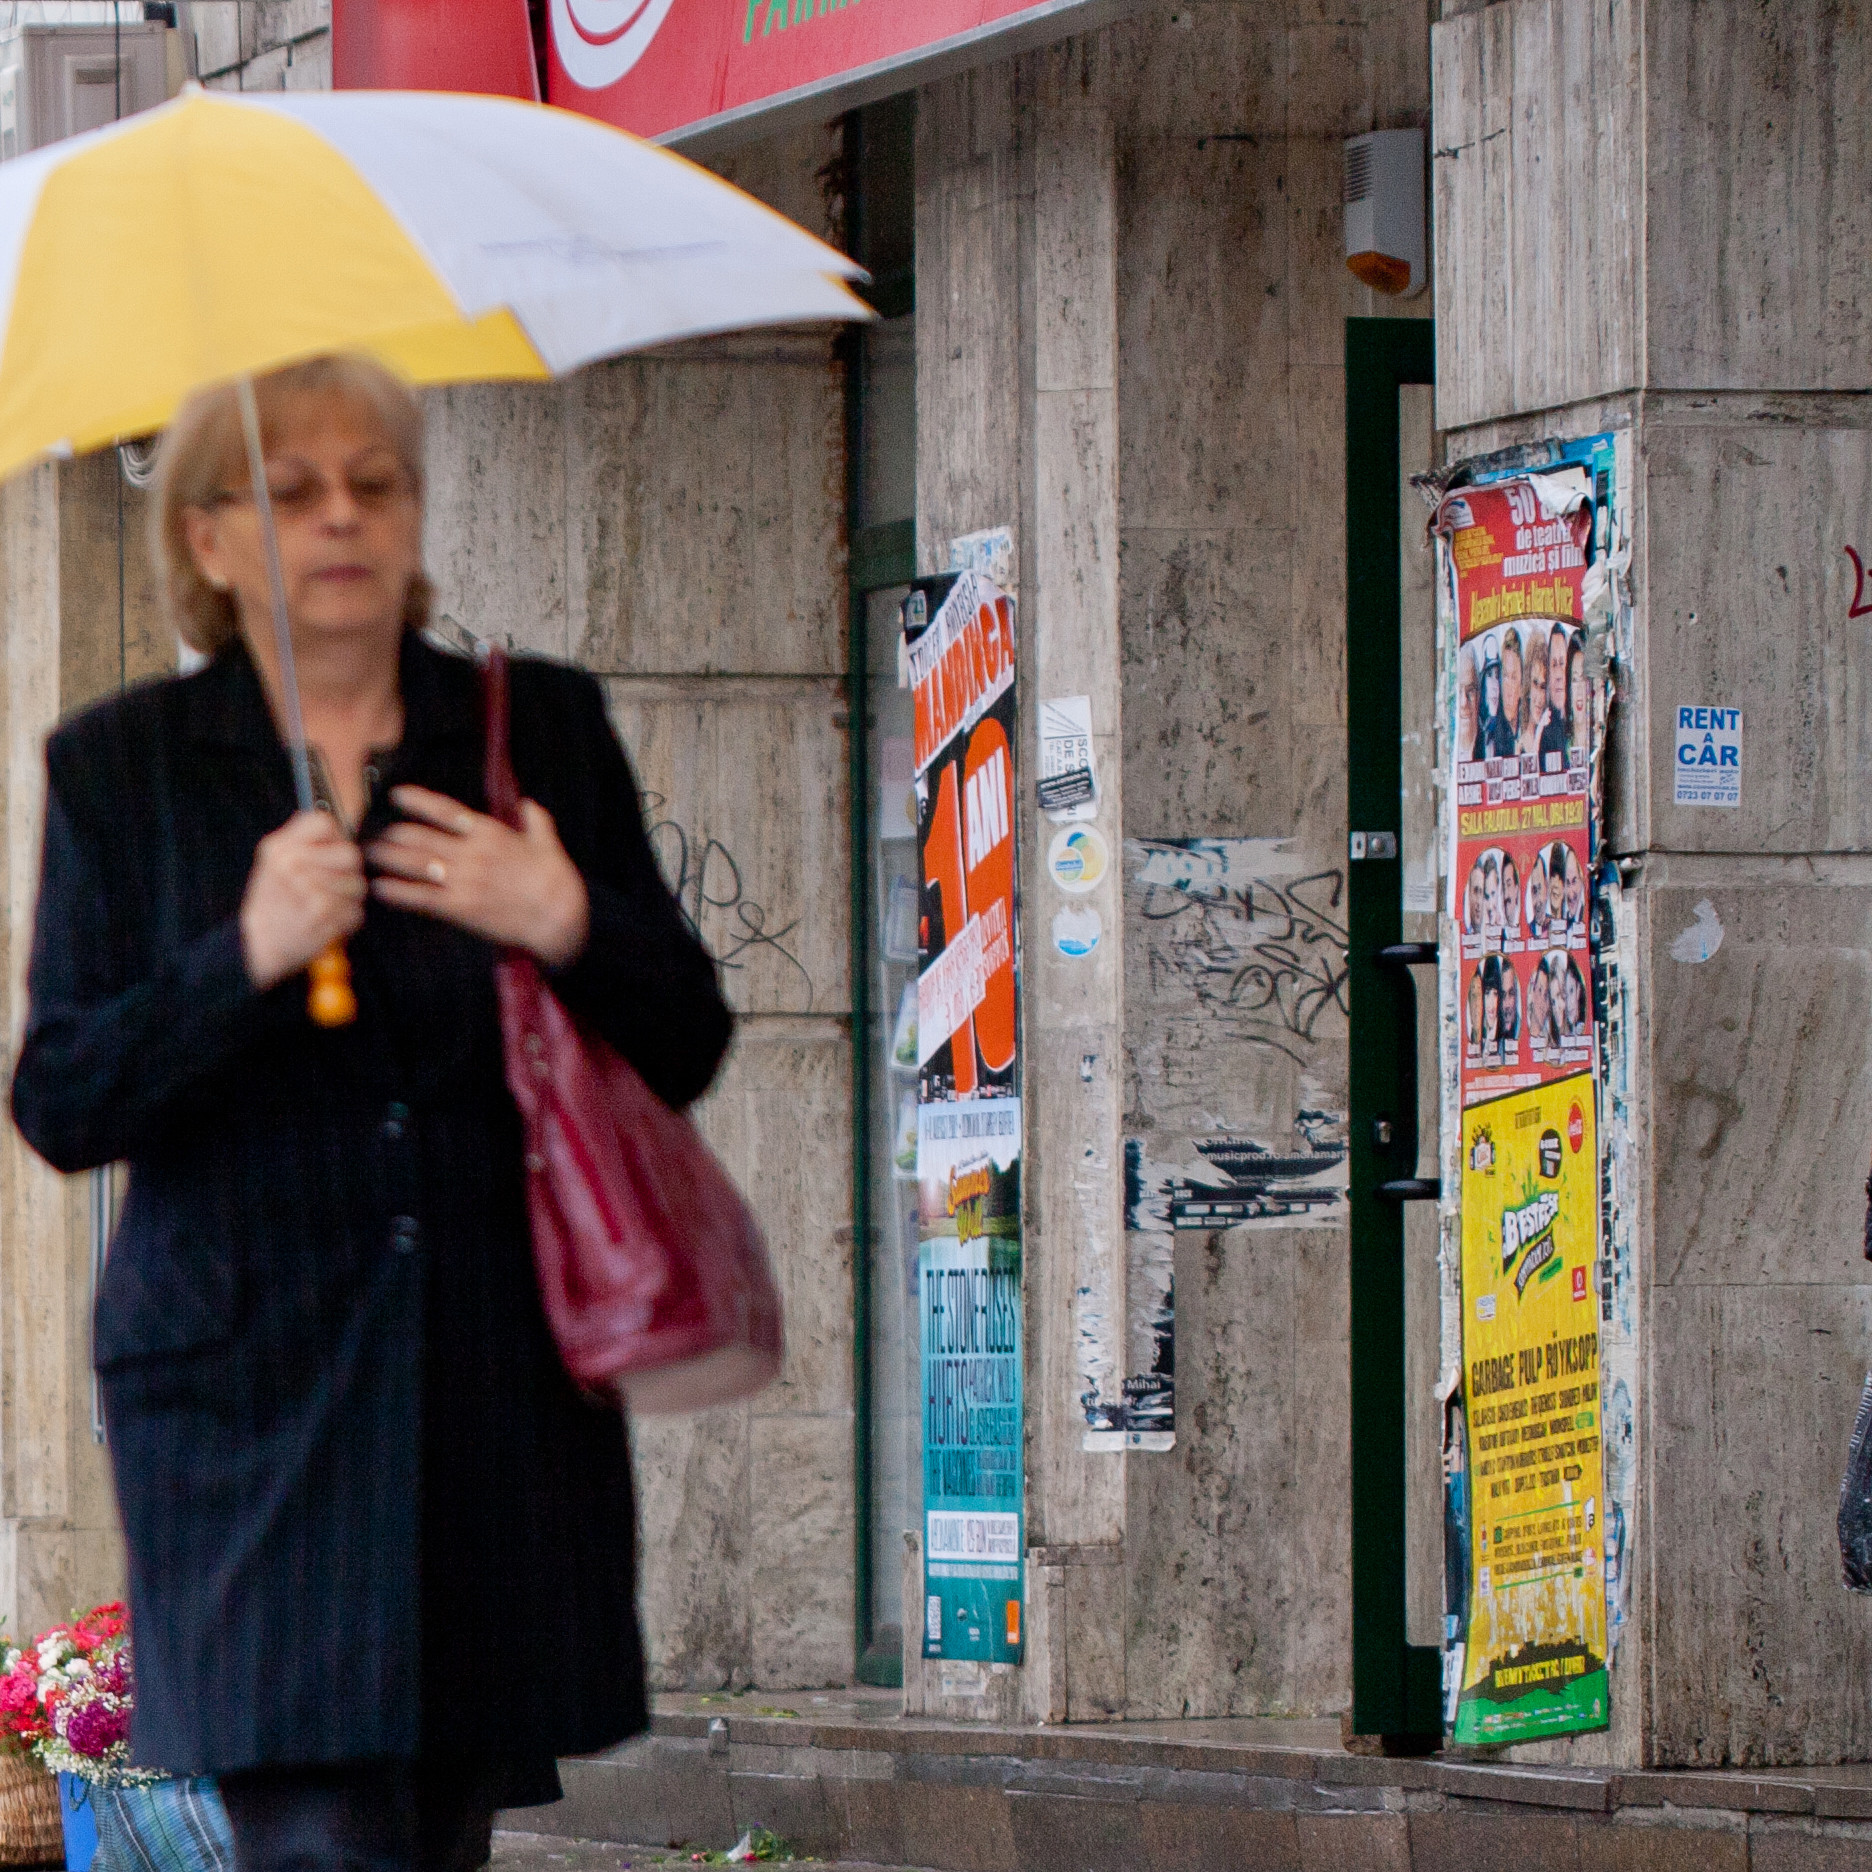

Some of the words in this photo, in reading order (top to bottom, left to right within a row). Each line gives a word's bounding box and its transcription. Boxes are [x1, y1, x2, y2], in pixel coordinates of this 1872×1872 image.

[1505, 485, 1536, 526] 50
[1516, 524, 1532, 550] de
[914, 595, 1015, 770] MANDINGA
[1679, 707, 1740, 730] RENT
[1703, 732, 1714, 743] A
[1678, 743, 1739, 767] CAR
[967, 745, 1009, 874] ANI
[926, 1267, 945, 1354] THE
[947, 1267, 979, 1354] STONE
[980, 1266, 1016, 1354] ROSES
[1126, 1379, 1161, 1389] Mihai
[1472, 1353, 1515, 1398] GARBAGE
[1519, 1346, 1543, 1387] PULP
[927, 1358, 968, 1444] HURTS
